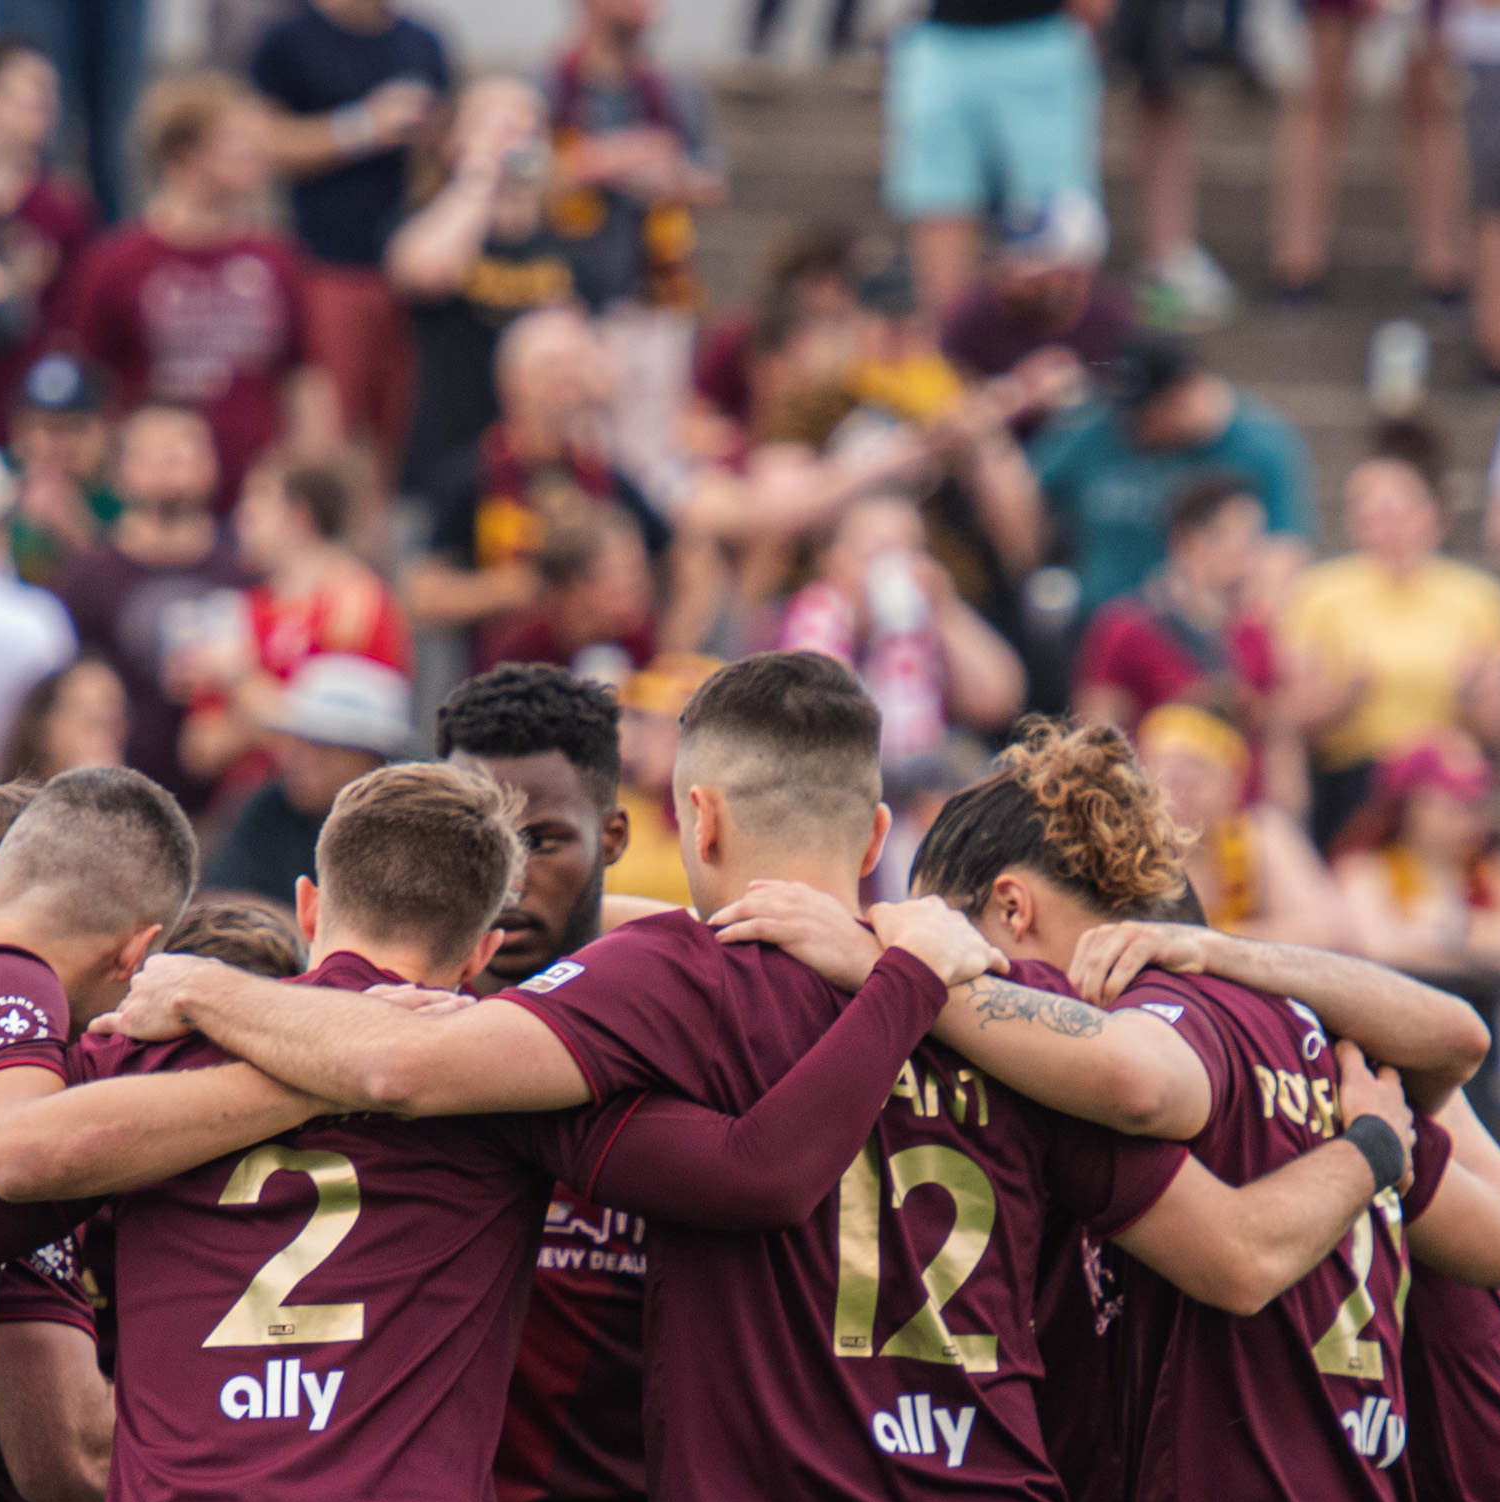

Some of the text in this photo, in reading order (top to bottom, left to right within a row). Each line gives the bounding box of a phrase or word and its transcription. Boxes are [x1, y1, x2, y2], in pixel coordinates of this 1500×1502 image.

[201, 1145, 366, 1350] 2
[537, 1246, 586, 1270] EVY
[833, 1122, 1000, 1375] 12
[219, 1357, 346, 1432] ally
[871, 1394, 978, 1469] ally
